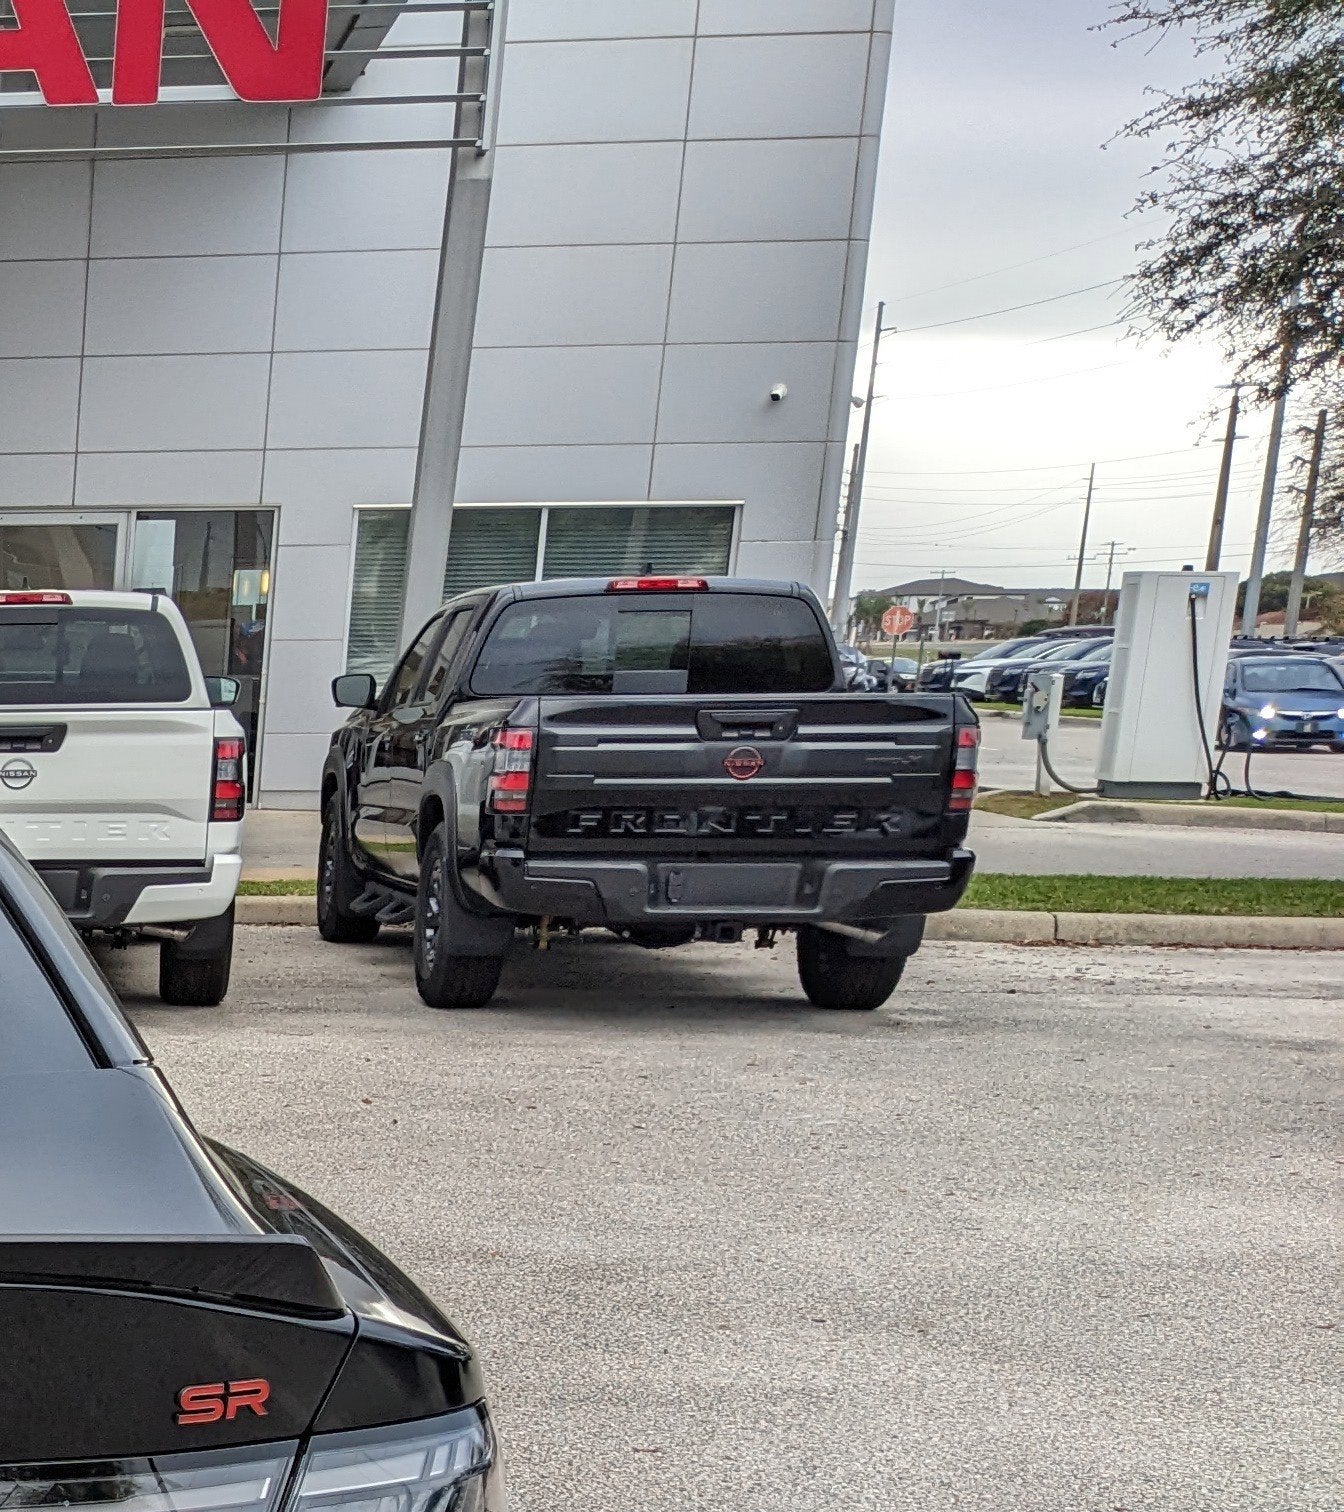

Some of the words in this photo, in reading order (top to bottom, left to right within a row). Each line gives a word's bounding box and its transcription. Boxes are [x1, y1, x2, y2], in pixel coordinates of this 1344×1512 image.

[884, 613, 912, 626] STOP
[566, 810, 902, 833] FRONTIER
[177, 1378, 271, 1426] SR
